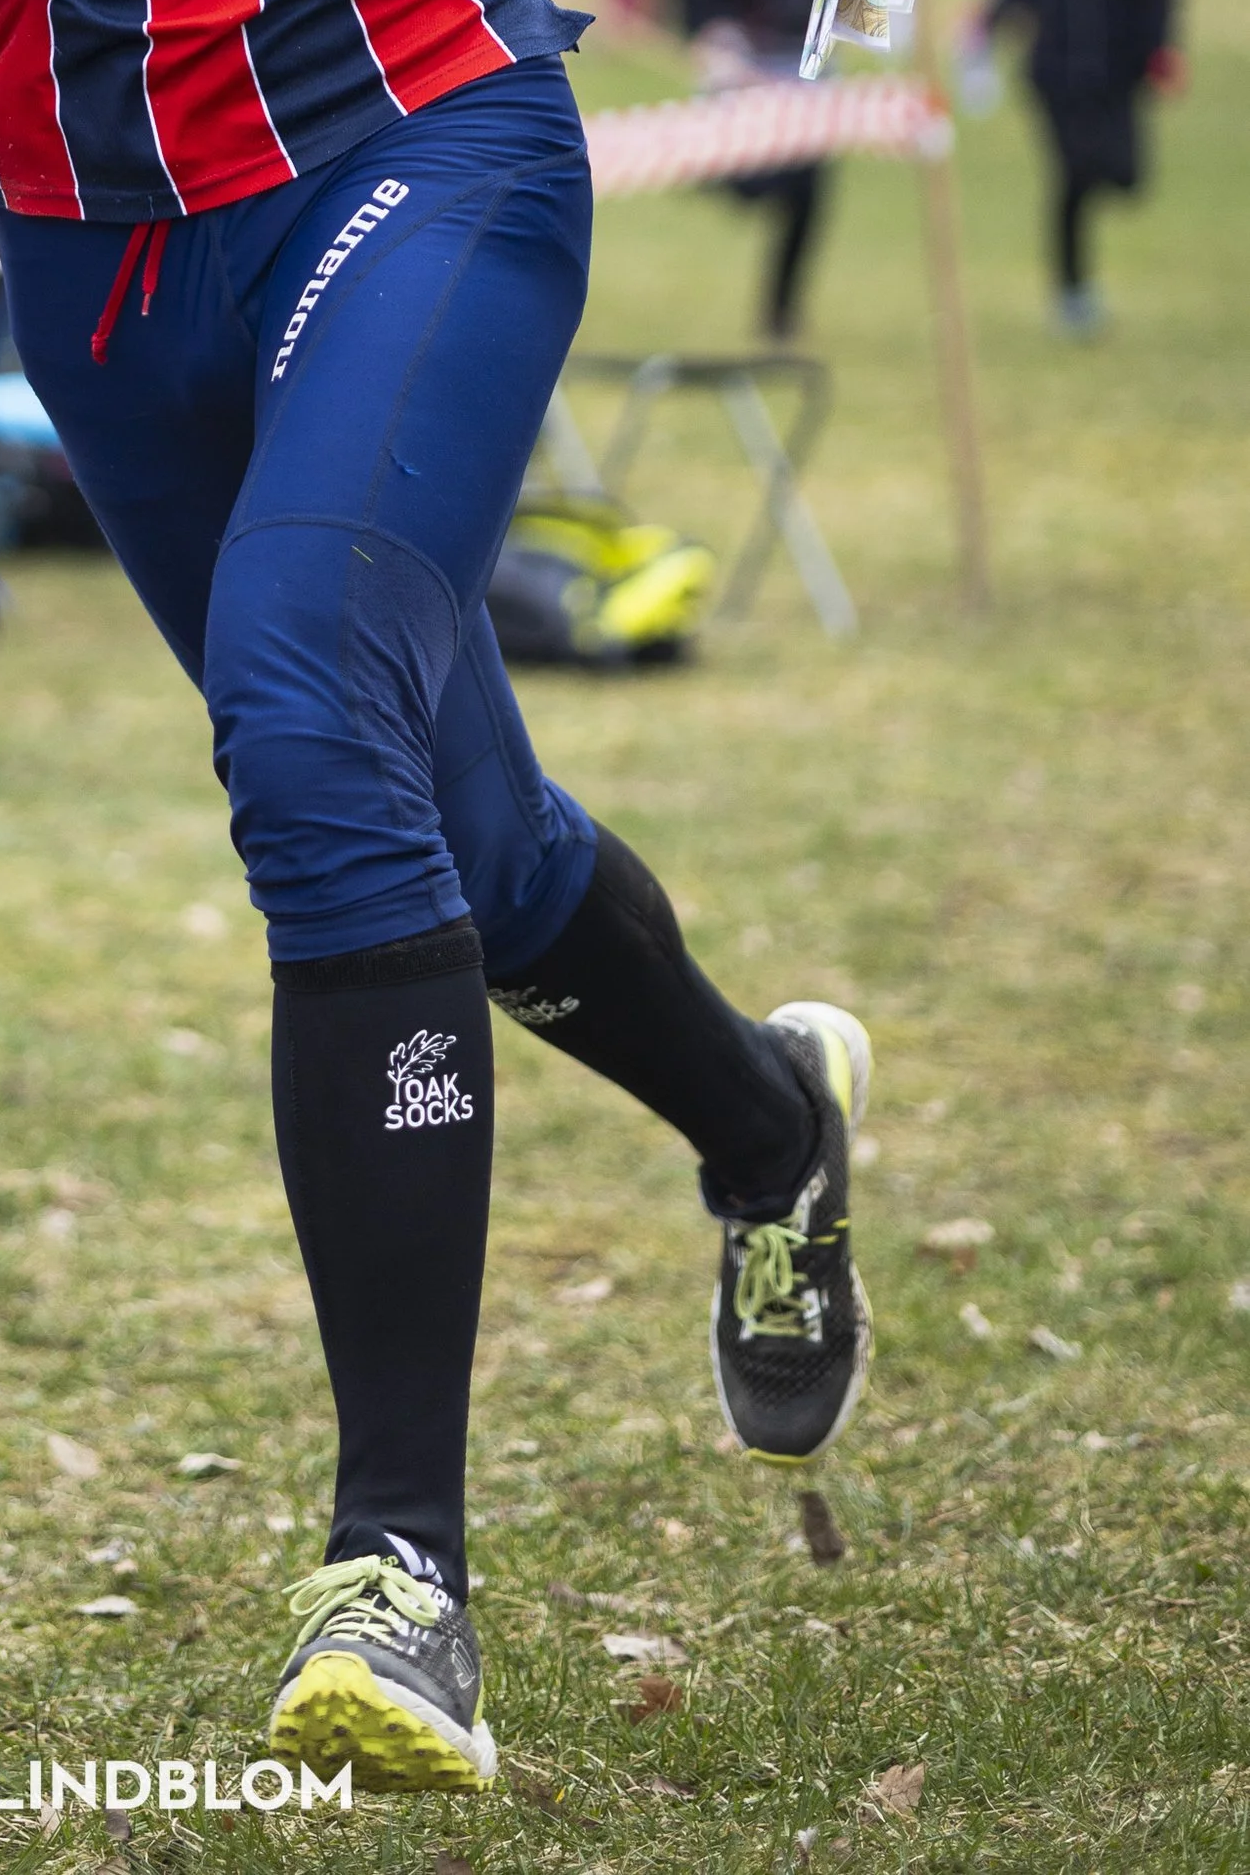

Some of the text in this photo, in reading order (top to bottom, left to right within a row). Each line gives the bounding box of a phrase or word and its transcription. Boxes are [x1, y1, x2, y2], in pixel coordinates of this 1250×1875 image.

[271, 178, 410, 382] noname
[404, 1073, 461, 1103] OAK
[384, 1094, 474, 1131] SOCKS
